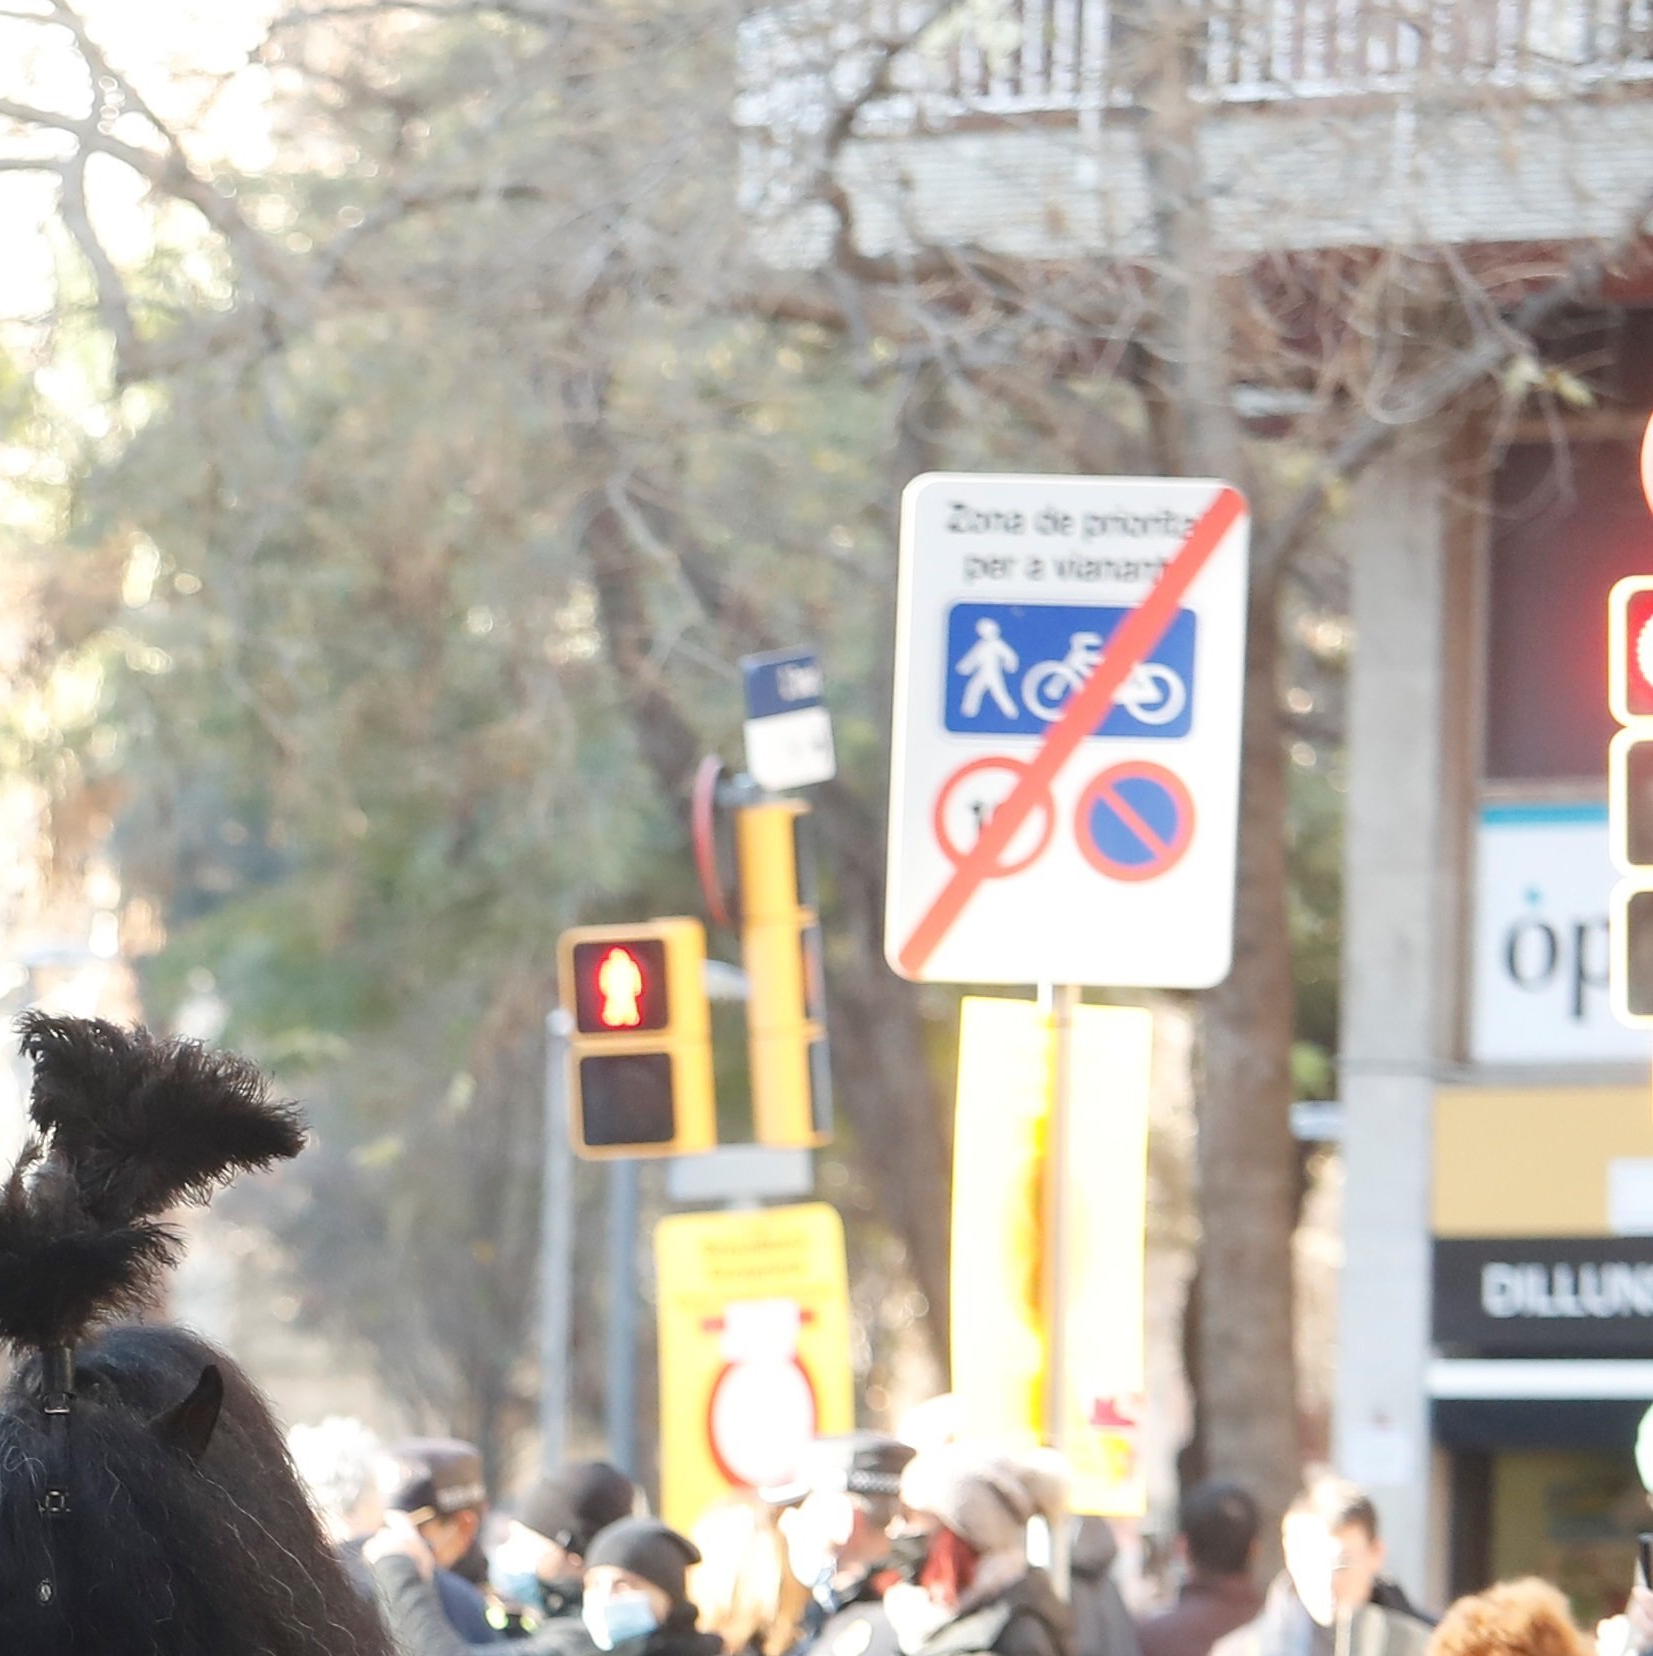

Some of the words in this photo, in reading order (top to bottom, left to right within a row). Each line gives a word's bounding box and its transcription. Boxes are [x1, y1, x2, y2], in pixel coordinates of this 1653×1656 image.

[947, 501, 1023, 535] Zona
[1031, 504, 1074, 535] de
[1082, 505, 1196, 541] priorita
[963, 554, 1015, 588] per
[1025, 556, 1045, 581] a
[1481, 1261, 1653, 1319] DILLUN
